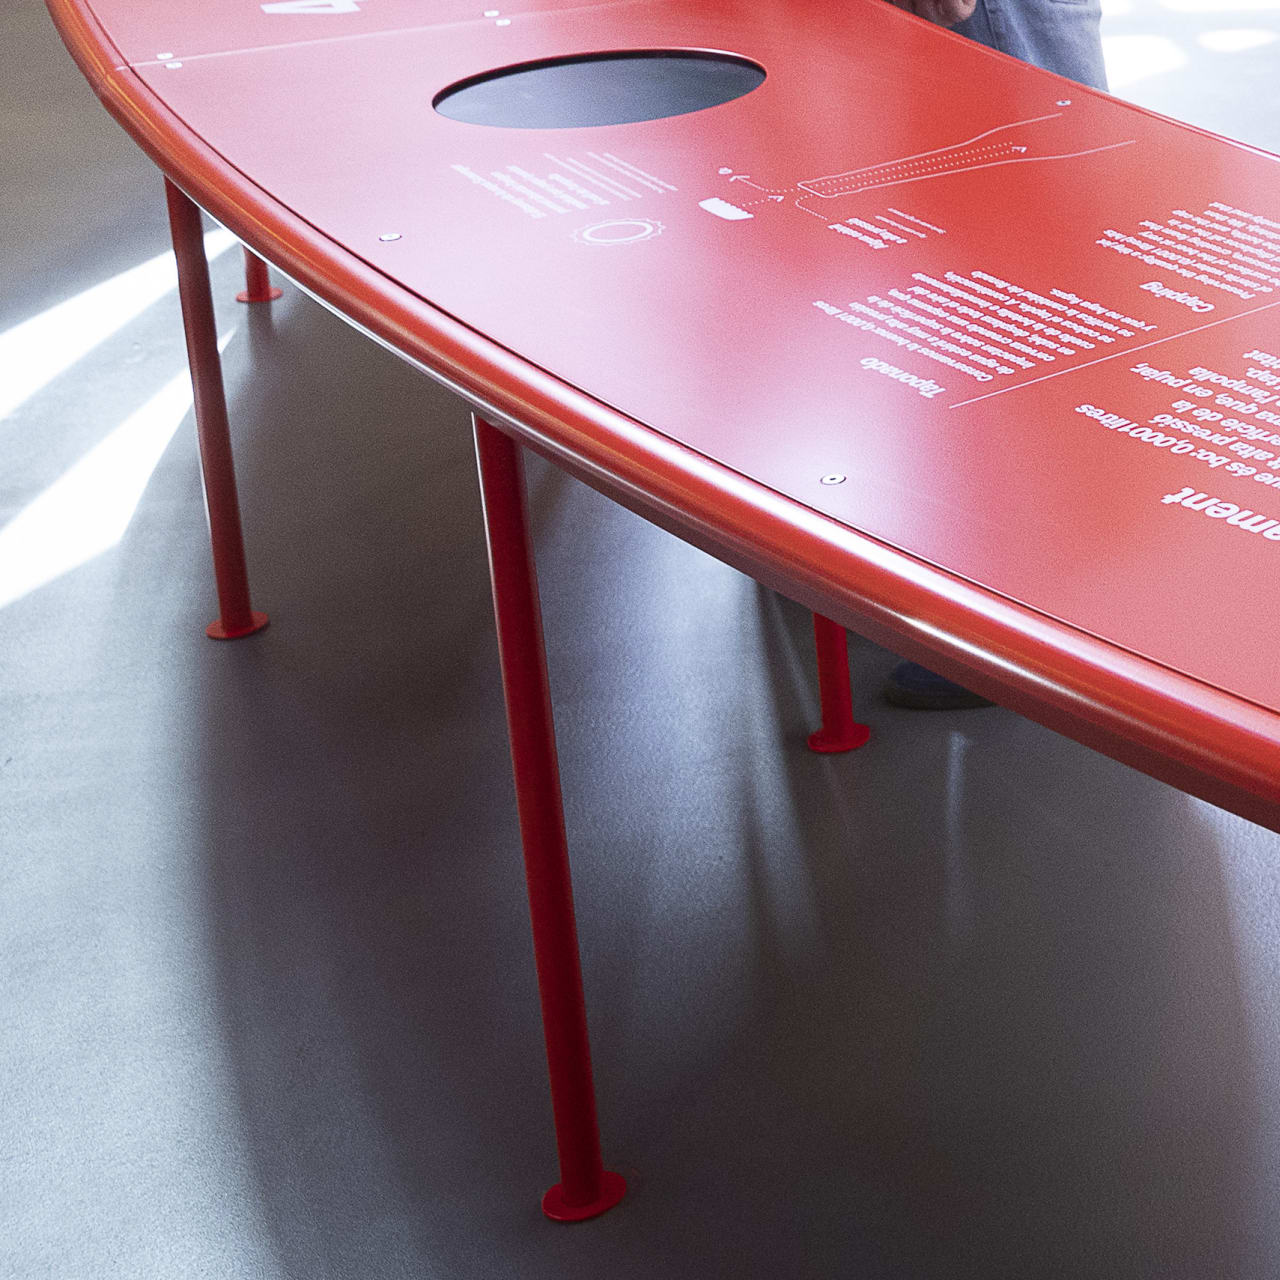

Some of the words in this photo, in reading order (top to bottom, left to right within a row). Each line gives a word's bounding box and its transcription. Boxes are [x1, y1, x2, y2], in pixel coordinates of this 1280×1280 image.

[1139, 282, 1215, 312] Capping
[859, 357, 945, 398] Taponado
[1182, 384, 1214, 397] en
[1171, 400, 1197, 413] la
[1215, 393, 1258, 414] que,
[1192, 408, 1224, 421] de
[1148, 414, 1239, 446] pressió
[1189, 449, 1231, 468] bo:
[1228, 441, 1275, 460] alta
[1225, 462, 1257, 477] és
